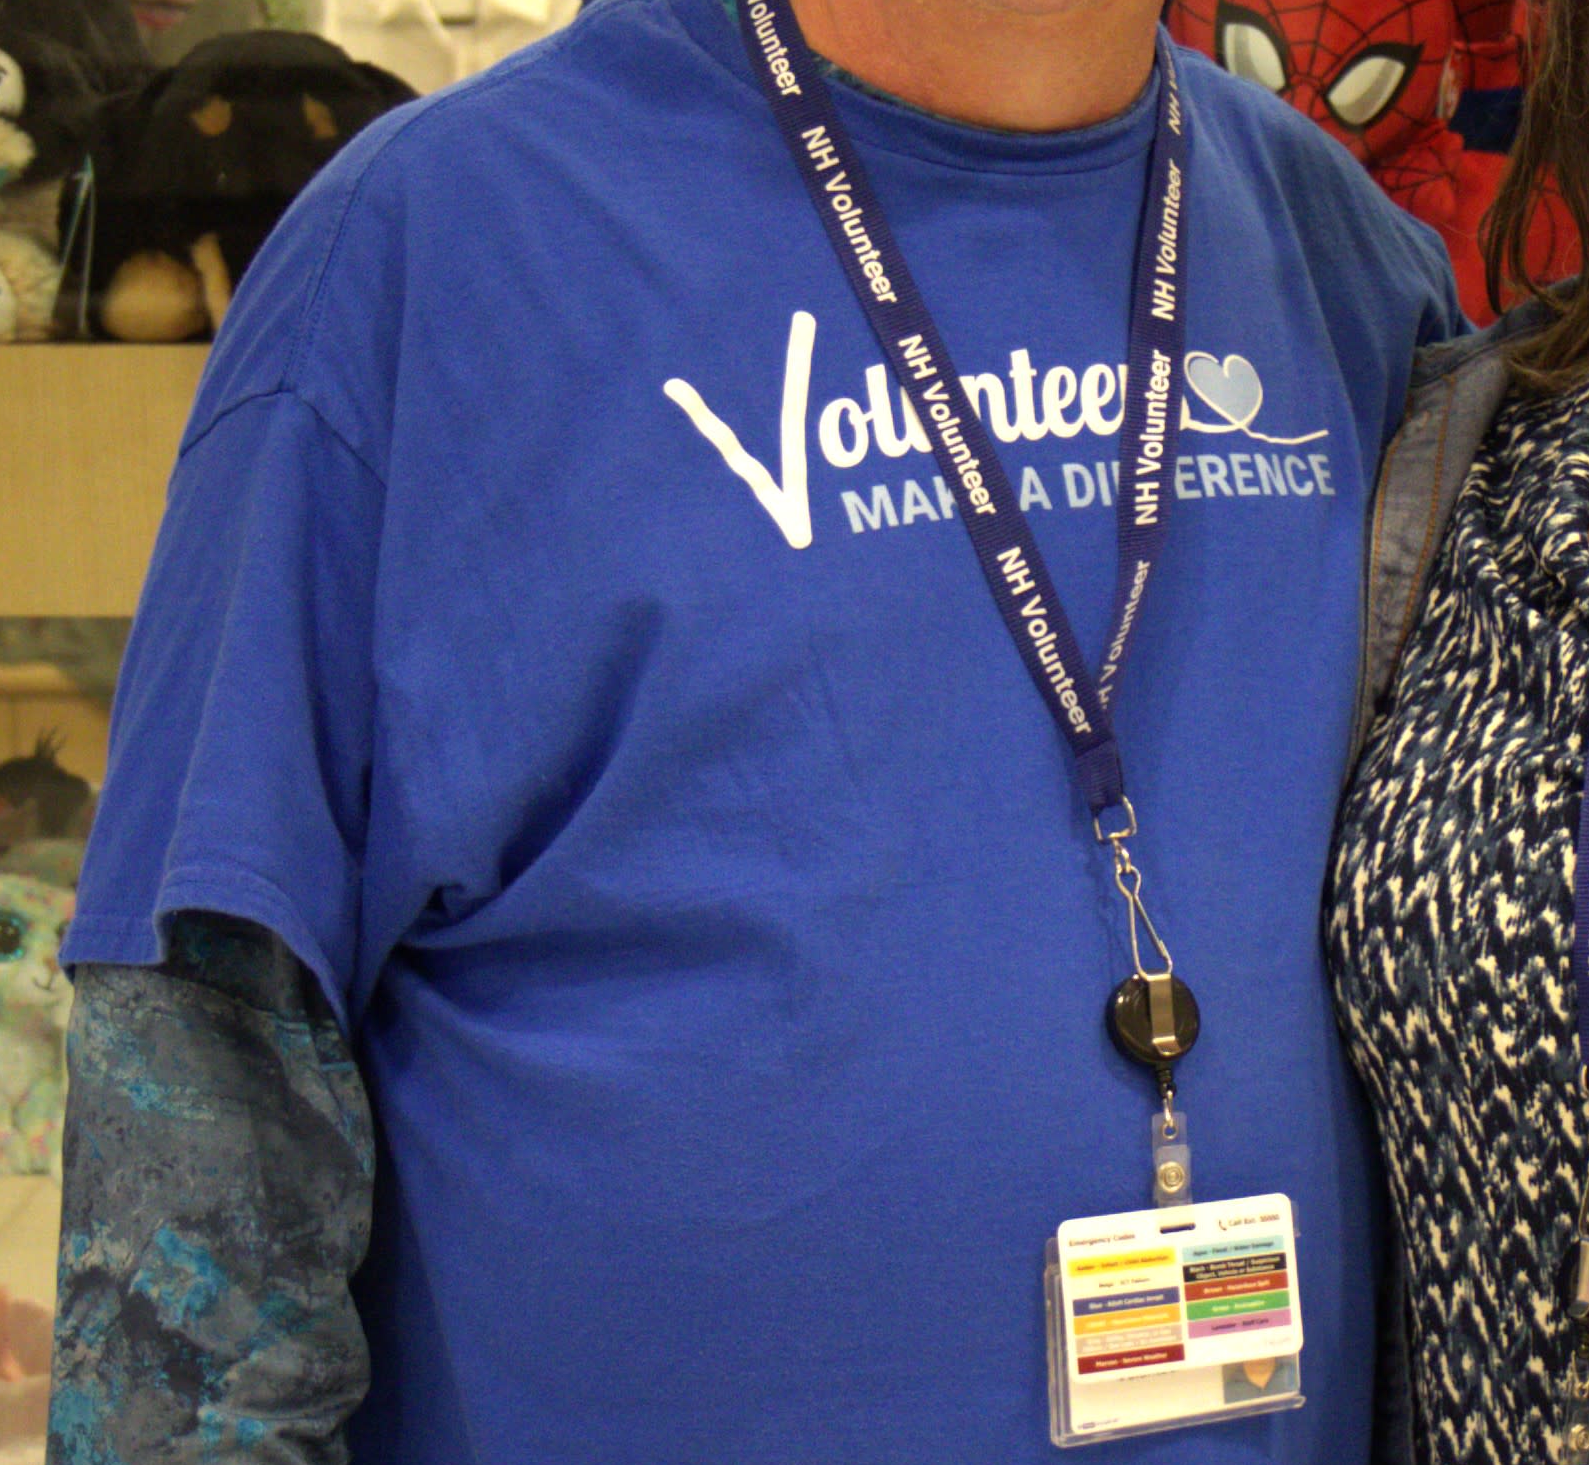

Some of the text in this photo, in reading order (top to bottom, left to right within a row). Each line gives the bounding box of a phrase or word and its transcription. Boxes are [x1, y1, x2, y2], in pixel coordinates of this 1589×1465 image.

[801, 125, 898, 305] NH Volunteer
[1151, 158, 1182, 322] NH Volunteer
[898, 334, 997, 518] NH Volunteer
[1018, 465, 1054, 514] A
[1061, 452, 1337, 511] DIERENCE
[1135, 349, 1172, 526] NH Volunteer
[996, 545, 1092, 735] NH Volunteer
[1099, 559, 1151, 685] Volunteer
